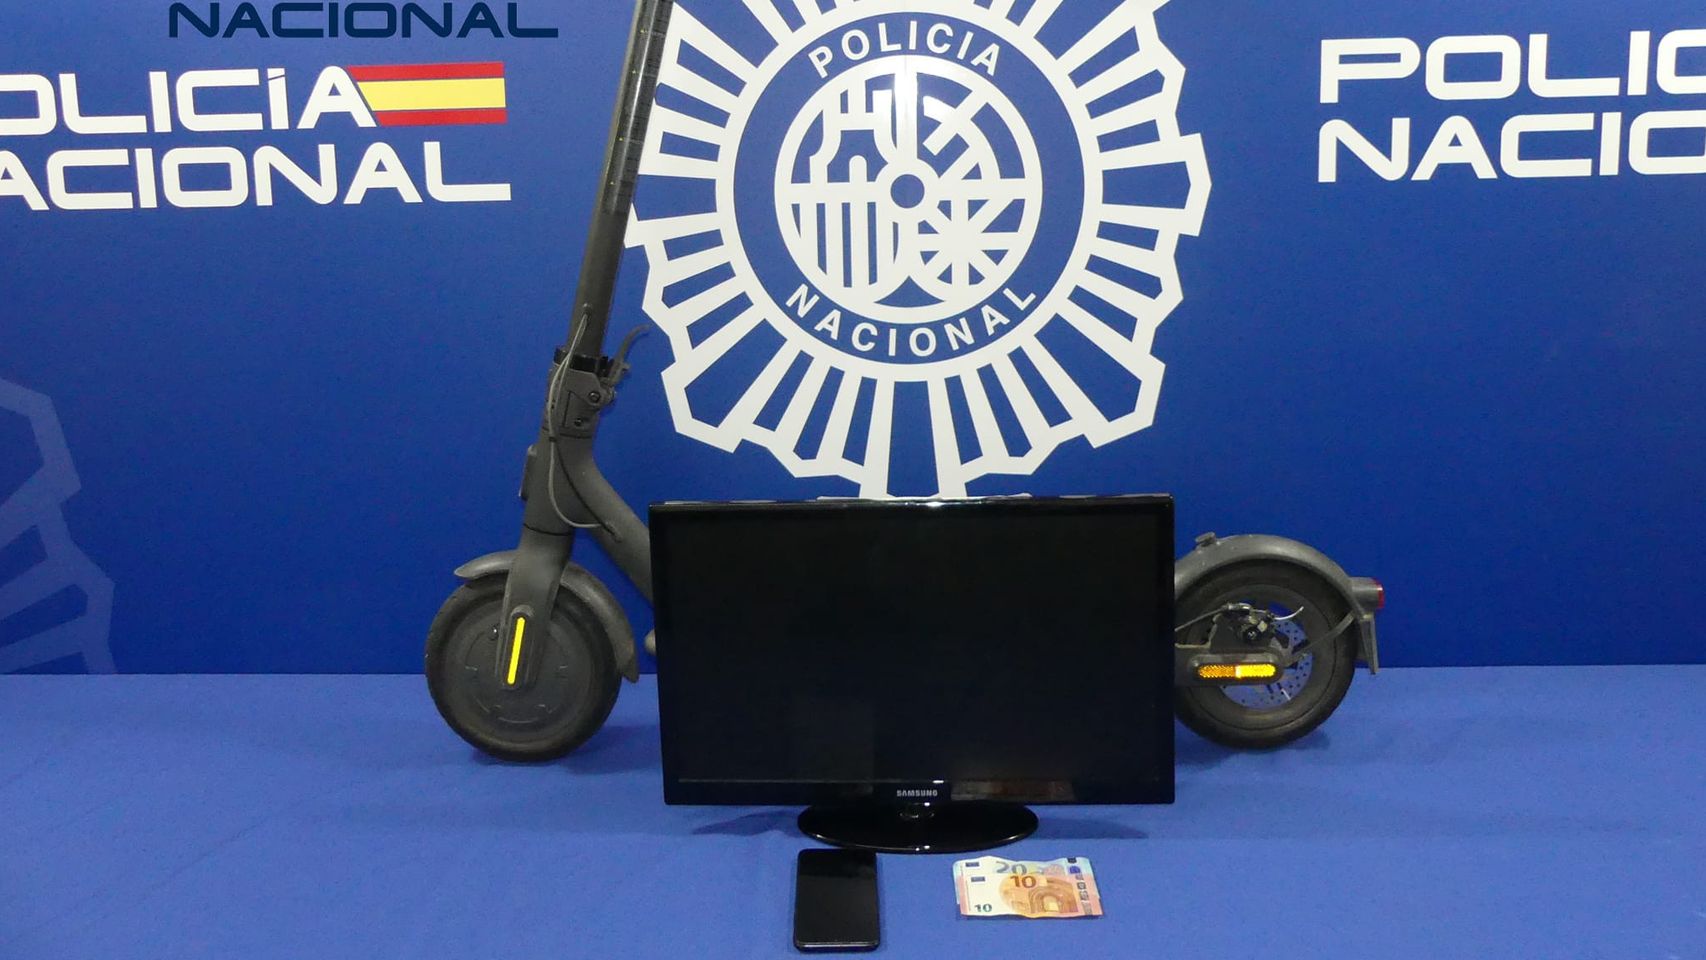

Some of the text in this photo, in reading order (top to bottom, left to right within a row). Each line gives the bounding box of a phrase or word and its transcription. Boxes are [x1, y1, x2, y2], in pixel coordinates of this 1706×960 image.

[168, 1, 559, 38] NACIONAL
[808, 20, 1001, 79] POLICIA
[1317, 109, 1706, 183] NACIO
[785, 283, 1037, 357] NACIONAL
[896, 789, 938, 797] SAMSUNG
[995, 860, 1028, 876] 20
[1010, 875, 1037, 889] 10
[974, 903, 993, 913] 10
